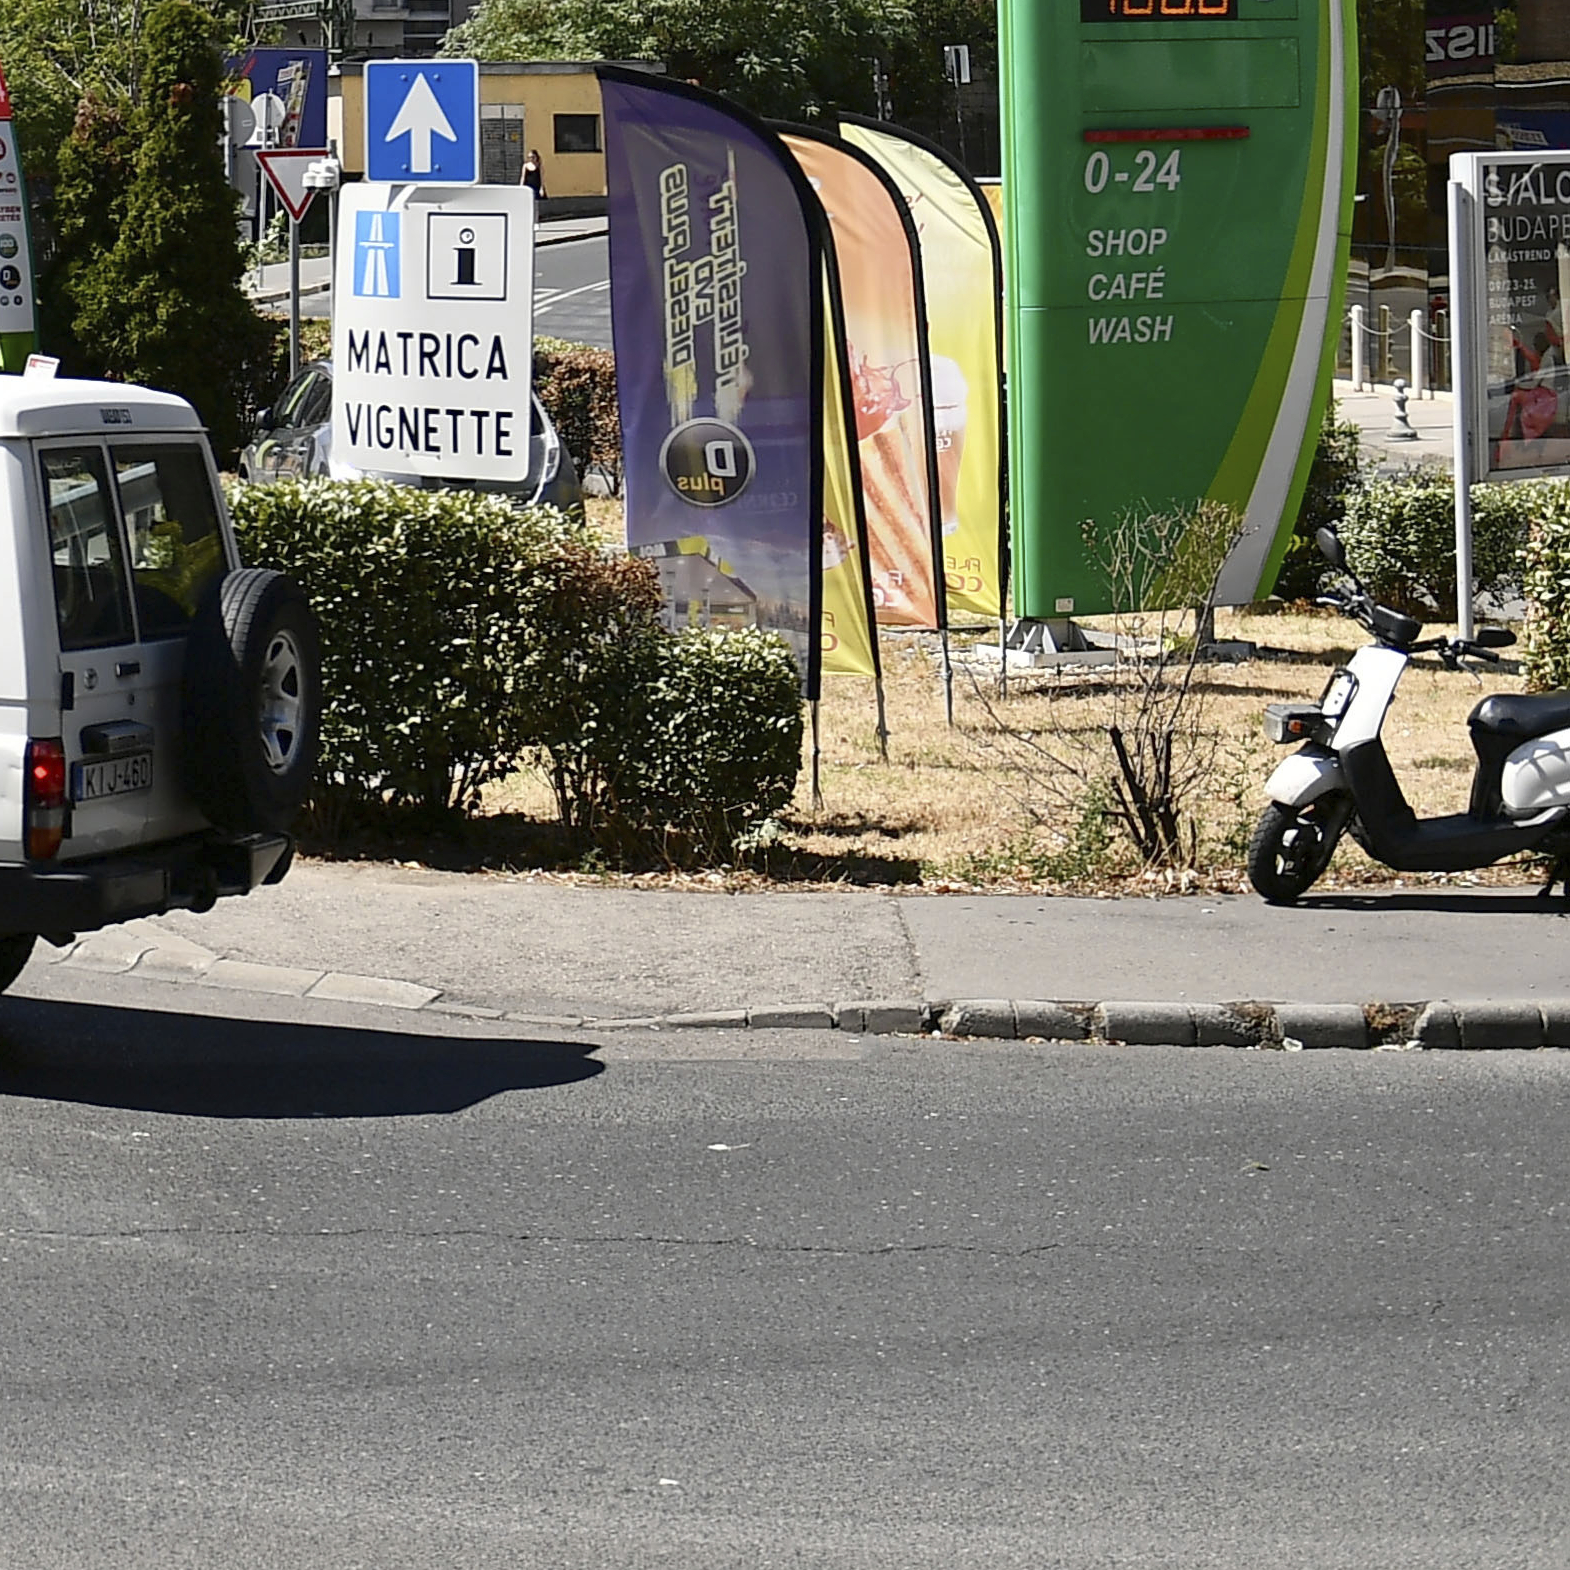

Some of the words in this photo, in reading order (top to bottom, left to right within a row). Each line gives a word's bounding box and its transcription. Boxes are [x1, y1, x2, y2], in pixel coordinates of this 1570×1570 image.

[1084, 150, 1181, 193] 0-24
[1086, 228, 1167, 256] SHOP
[1087, 267, 1164, 300] CAFÉ
[1087, 316, 1173, 345] WASH
[348, 330, 508, 380] MATRICA
[346, 403, 514, 457] VIGNETTE
[86, 757, 148, 797] KIJ-460
